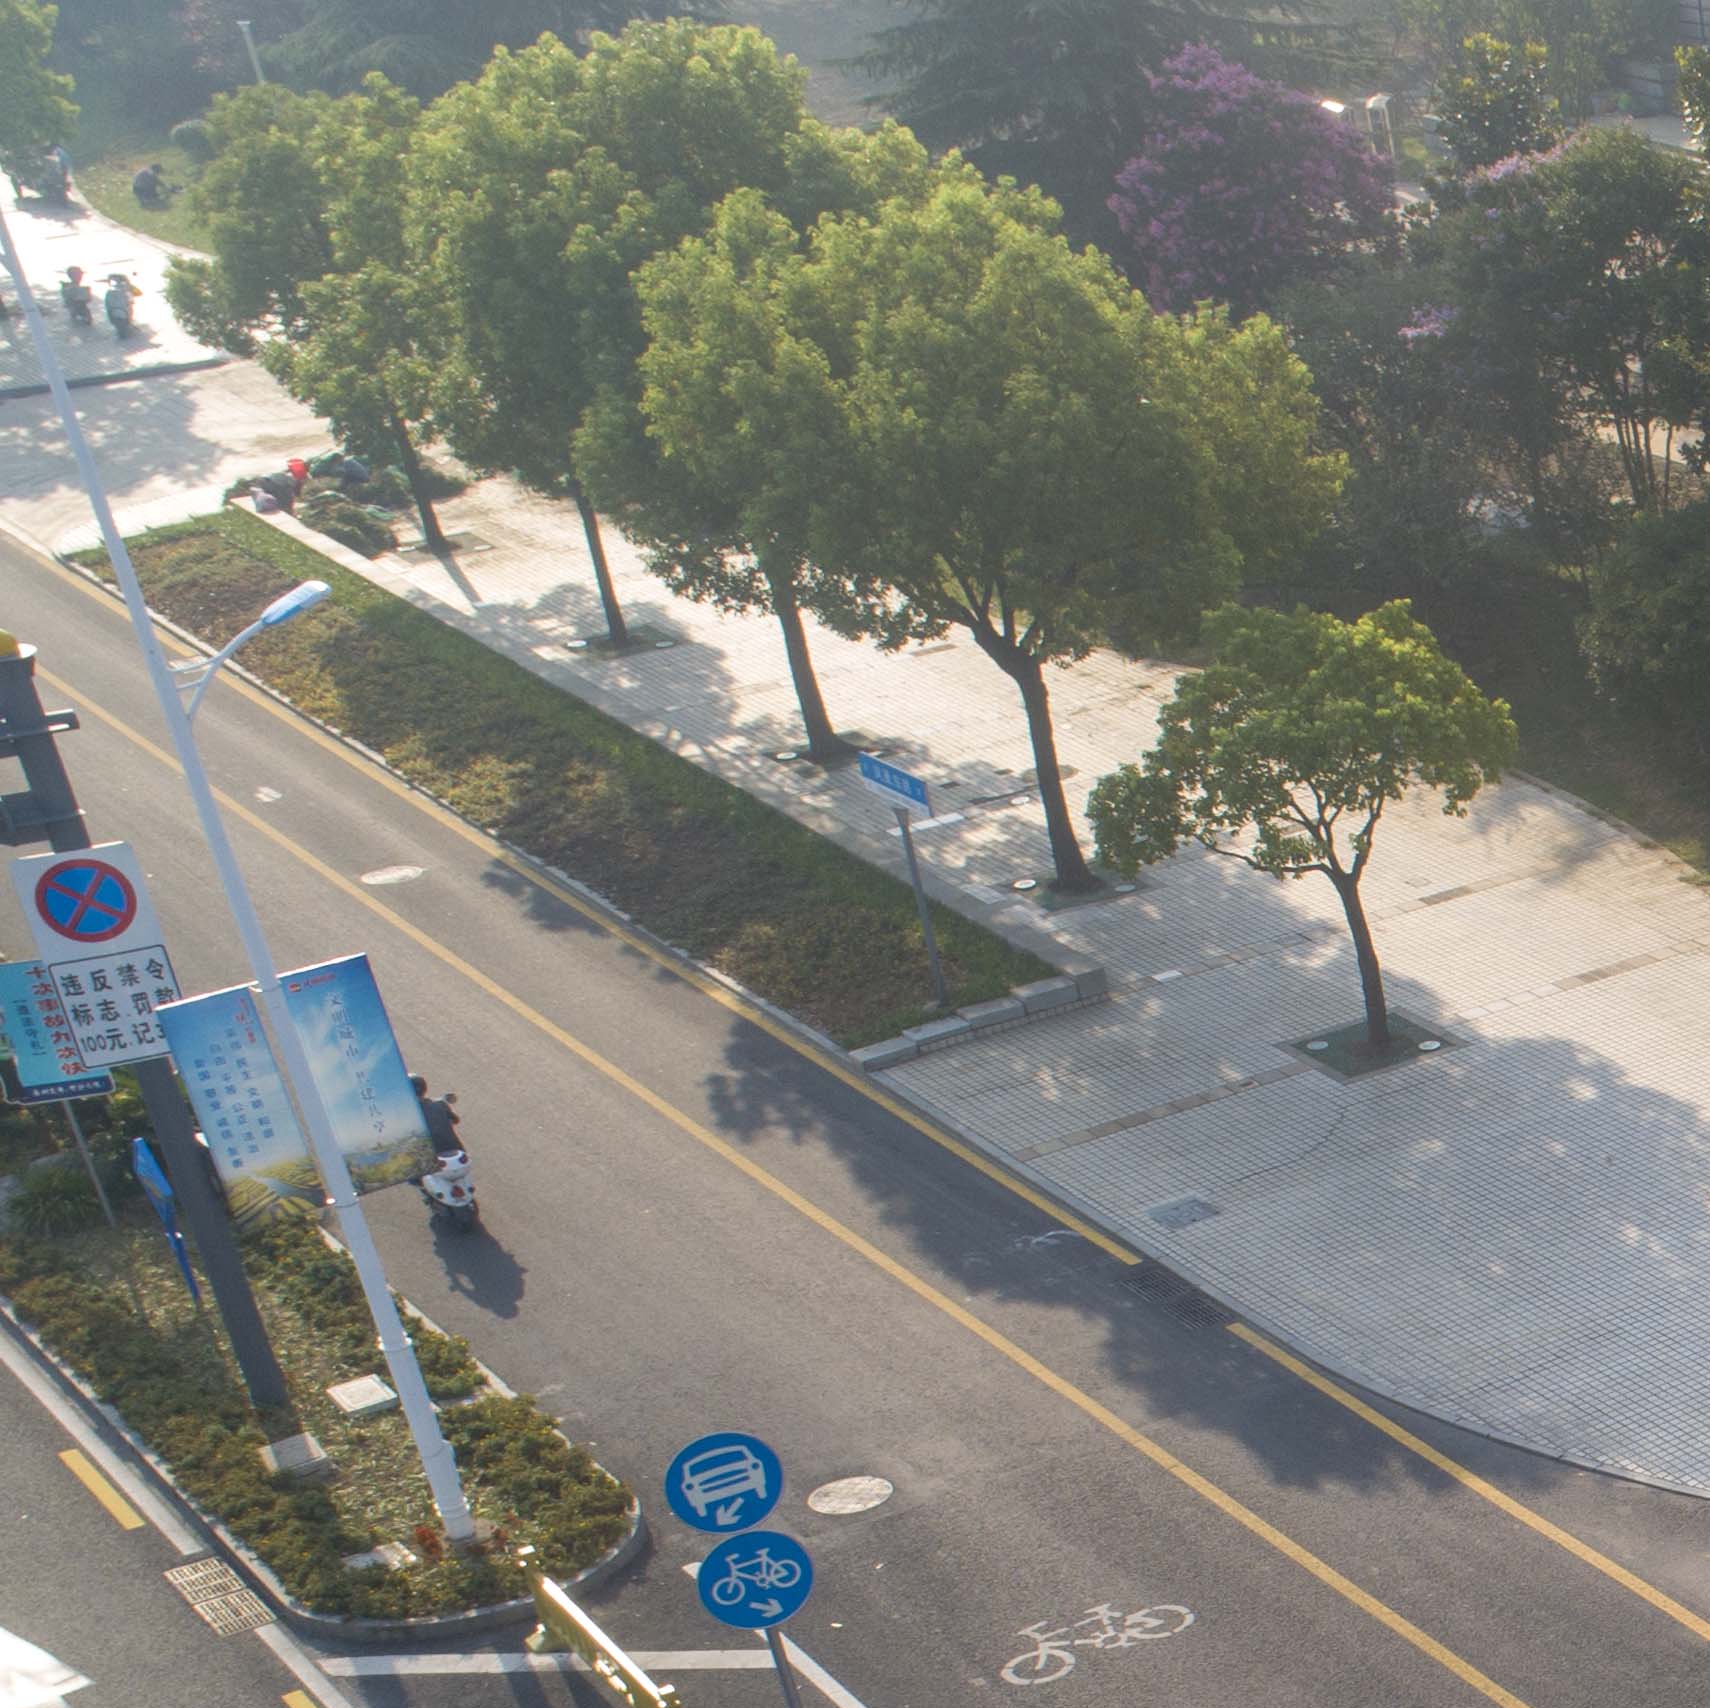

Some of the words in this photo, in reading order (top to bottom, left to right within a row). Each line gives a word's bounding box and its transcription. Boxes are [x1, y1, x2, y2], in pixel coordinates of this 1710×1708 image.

[60, 958, 164, 997] 违反禁令
[25, 966, 87, 1076] 十次事故九次快
